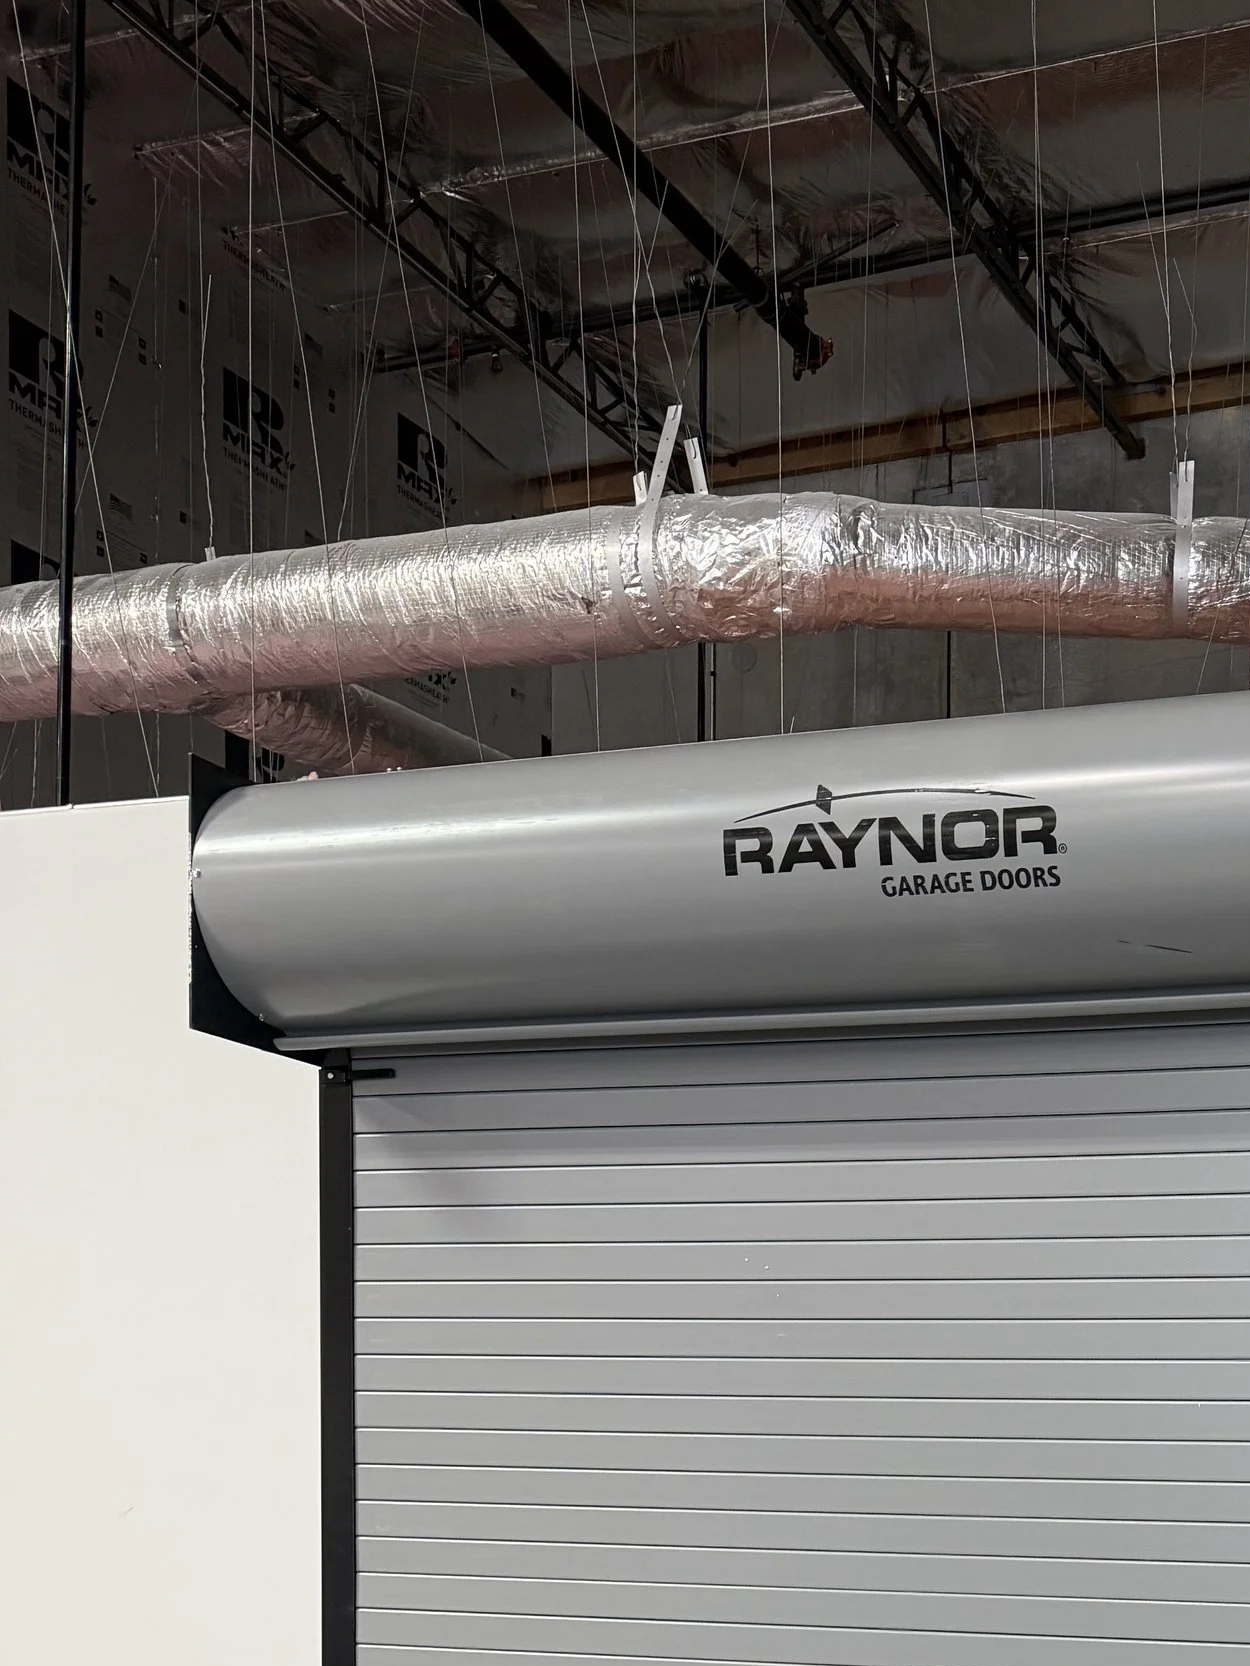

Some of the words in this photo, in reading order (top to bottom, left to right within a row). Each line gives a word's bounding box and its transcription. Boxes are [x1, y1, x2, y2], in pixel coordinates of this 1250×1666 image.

[723, 805, 1058, 877] RAYNOR
[881, 871, 974, 898] GARAGE
[979, 865, 1061, 893] DOORS
